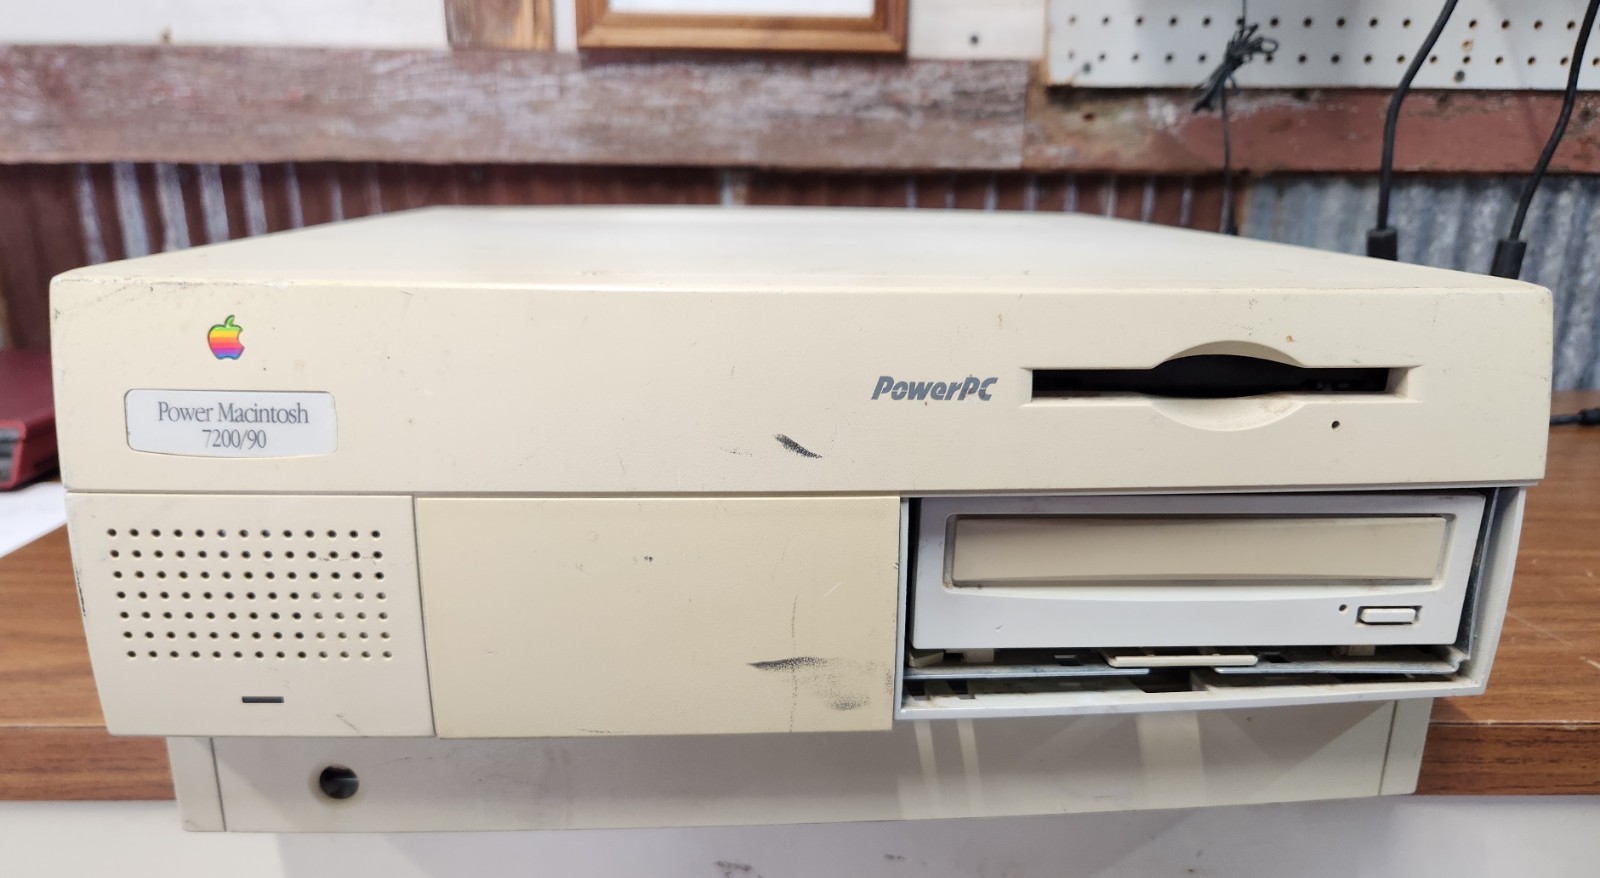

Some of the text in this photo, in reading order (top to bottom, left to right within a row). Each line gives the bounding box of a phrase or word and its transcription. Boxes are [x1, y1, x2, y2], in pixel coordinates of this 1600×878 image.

[871, 375, 998, 401] PowerPC
[157, 401, 309, 424] Power Macintosh
[201, 429, 267, 450] 7200/90
